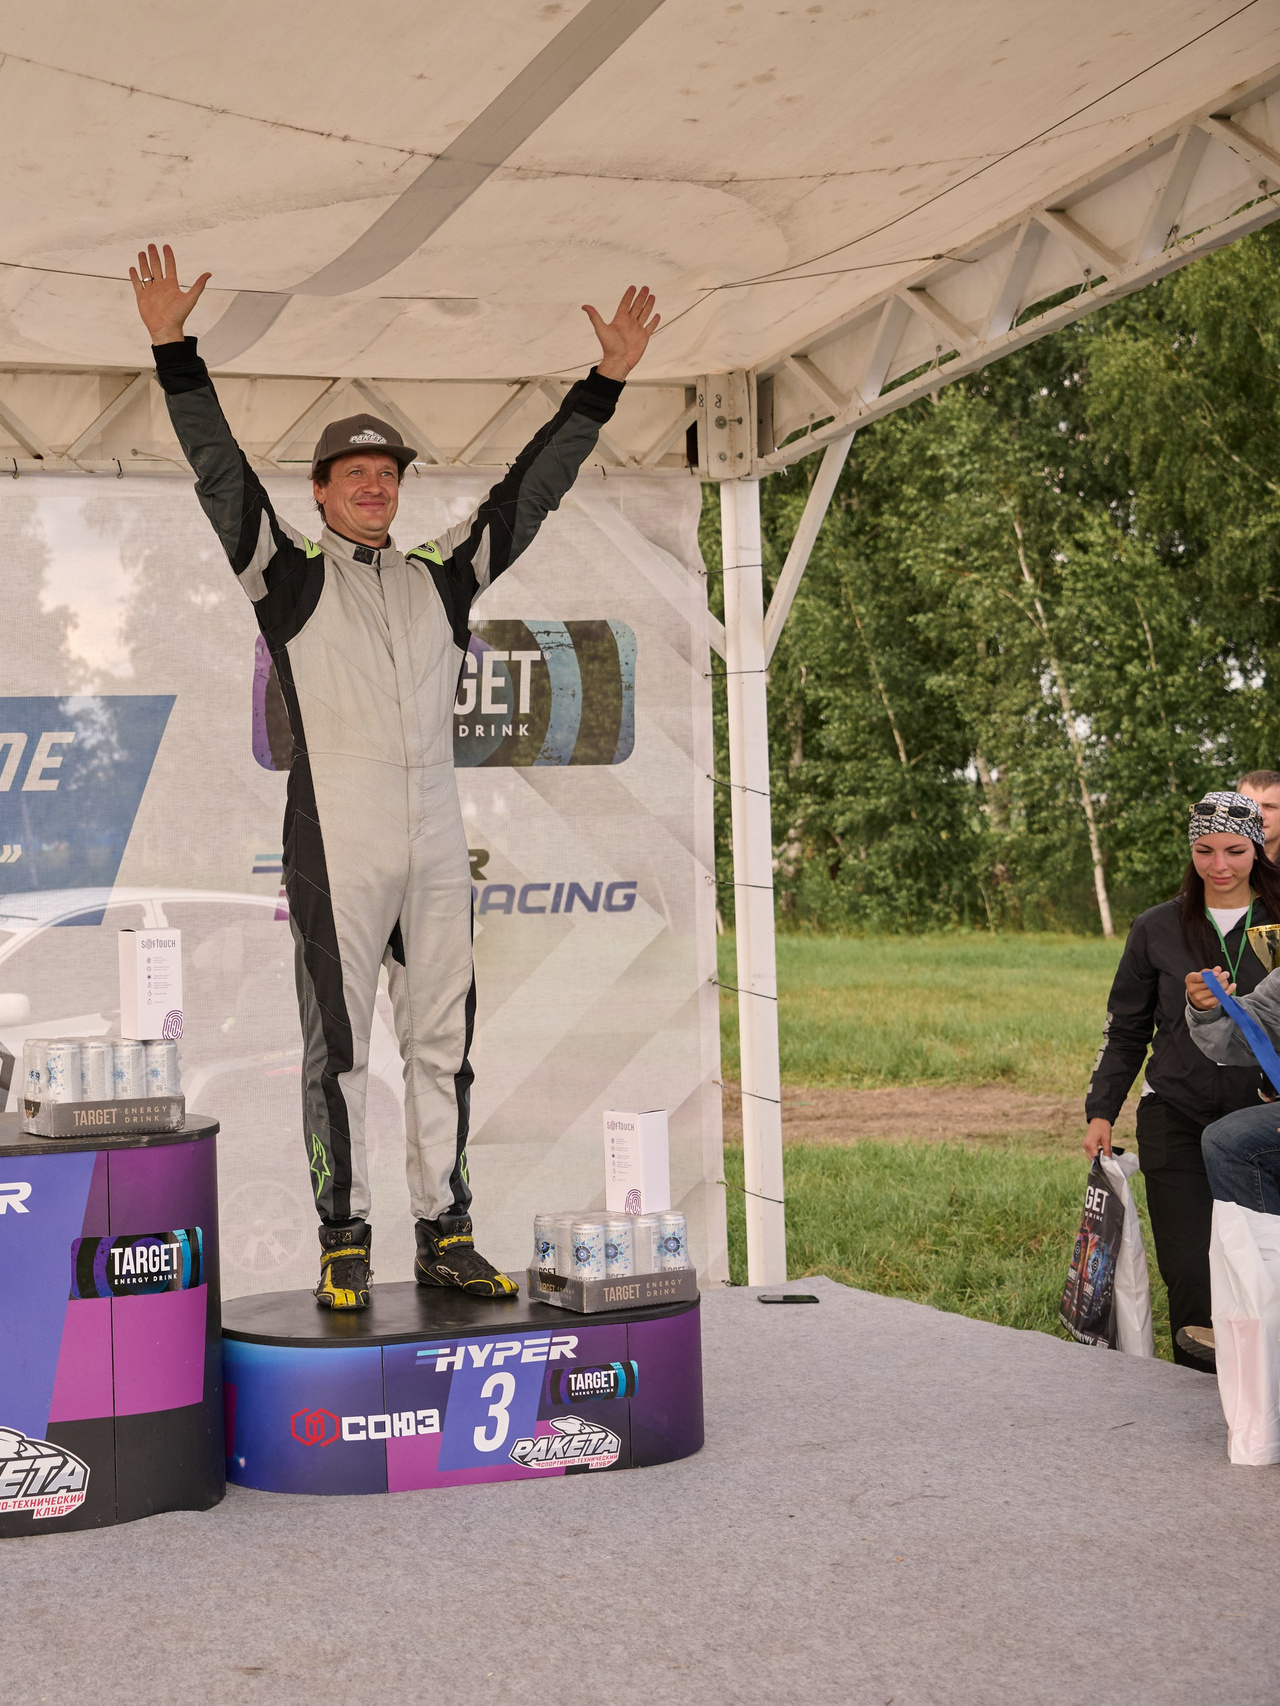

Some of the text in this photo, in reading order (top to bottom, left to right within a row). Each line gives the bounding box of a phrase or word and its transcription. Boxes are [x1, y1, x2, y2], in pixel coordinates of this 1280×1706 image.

[458, 724, 531, 737] DRINK
[73, 1105, 168, 1126] TARGET ENERGY
[124, 1115, 161, 1124] DRINK
[110, 1243, 181, 1275] TARGET
[114, 1273, 178, 1285] ENERGY DRINK
[603, 1279, 683, 1302] TARGET ENERGY
[646, 1287, 676, 1297] DRINK
[435, 1335, 579, 1372] HYPER
[569, 1370, 617, 1391] TARGET
[473, 1371, 516, 1453] 3
[341, 1408, 441, 1441] СОЮЗ
[511, 1434, 620, 1464] РАКЕТА
[540, 1453, 618, 1468] СПОРТИВНО-ТЕХНИЧЕСКИЙ
[590, 1460, 608, 1469] КЛУБ
[35, 1506, 65, 1517] КЛУБ
